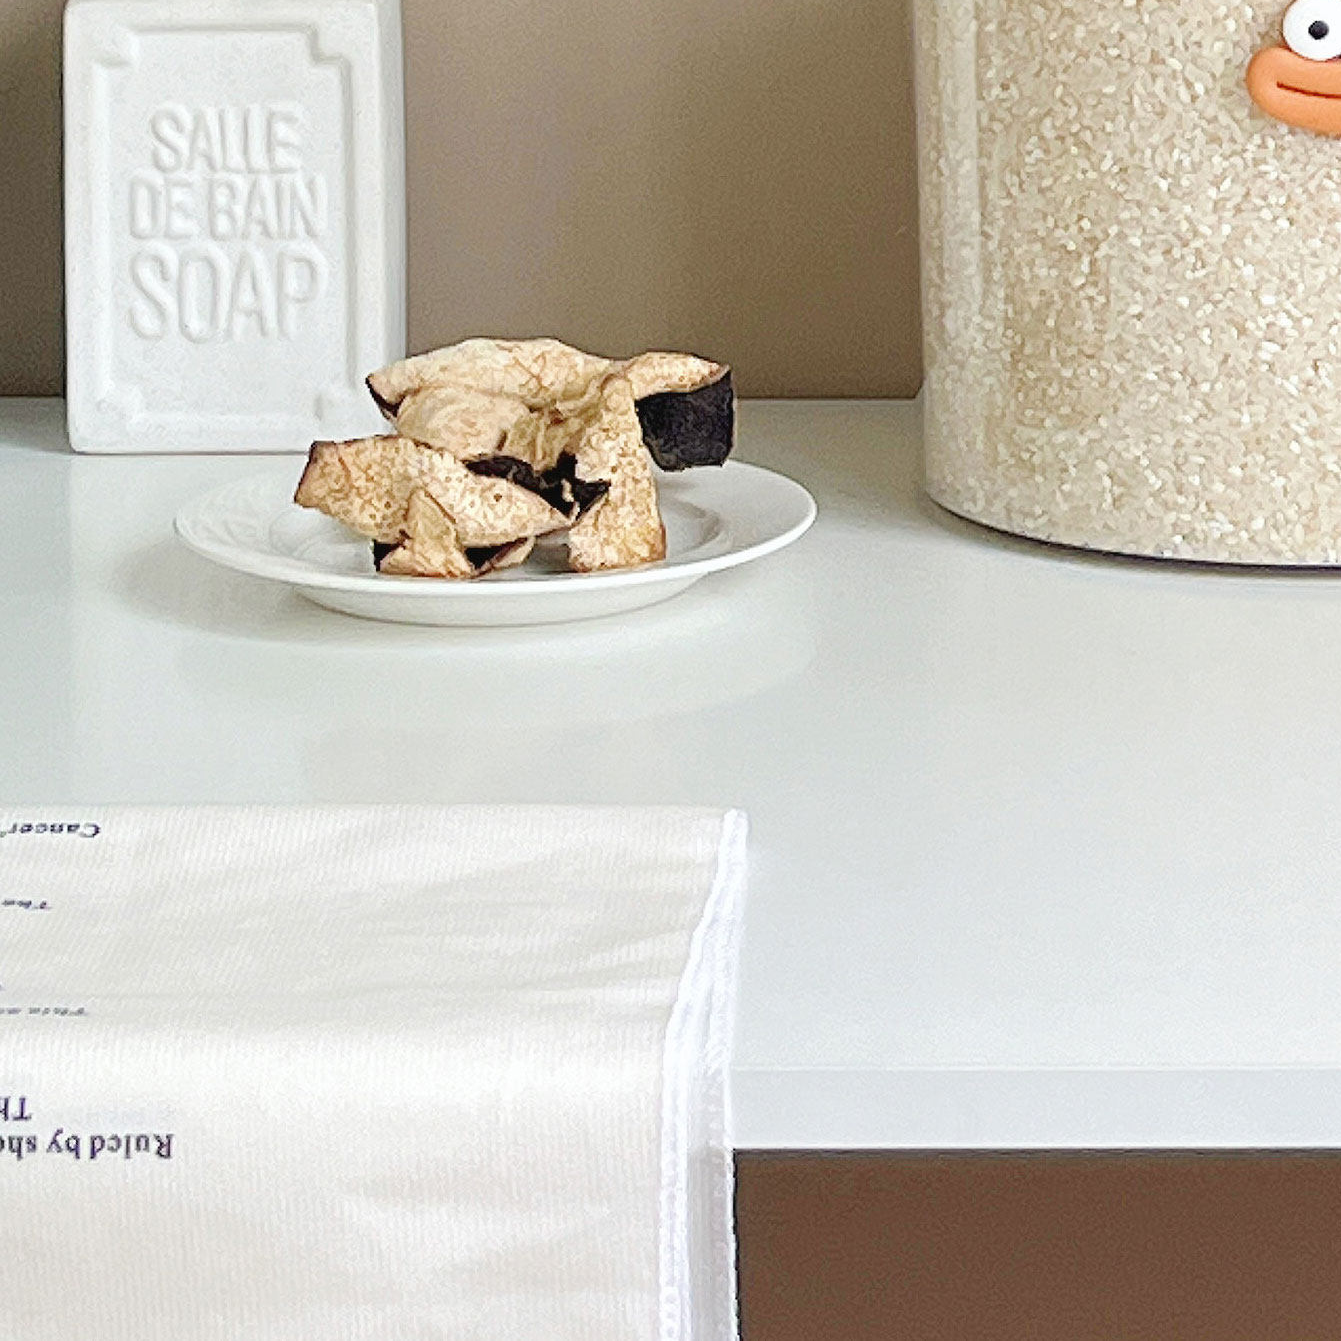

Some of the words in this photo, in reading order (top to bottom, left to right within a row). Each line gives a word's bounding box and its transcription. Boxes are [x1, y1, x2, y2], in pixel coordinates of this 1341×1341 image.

[149, 103, 302, 174] SALLE
[129, 174, 196, 240] DE
[205, 173, 328, 242] BAIN
[129, 243, 328, 345] SOAP
[46, 1127, 81, 1160] by
[89, 1133, 174, 1160] Ruled
